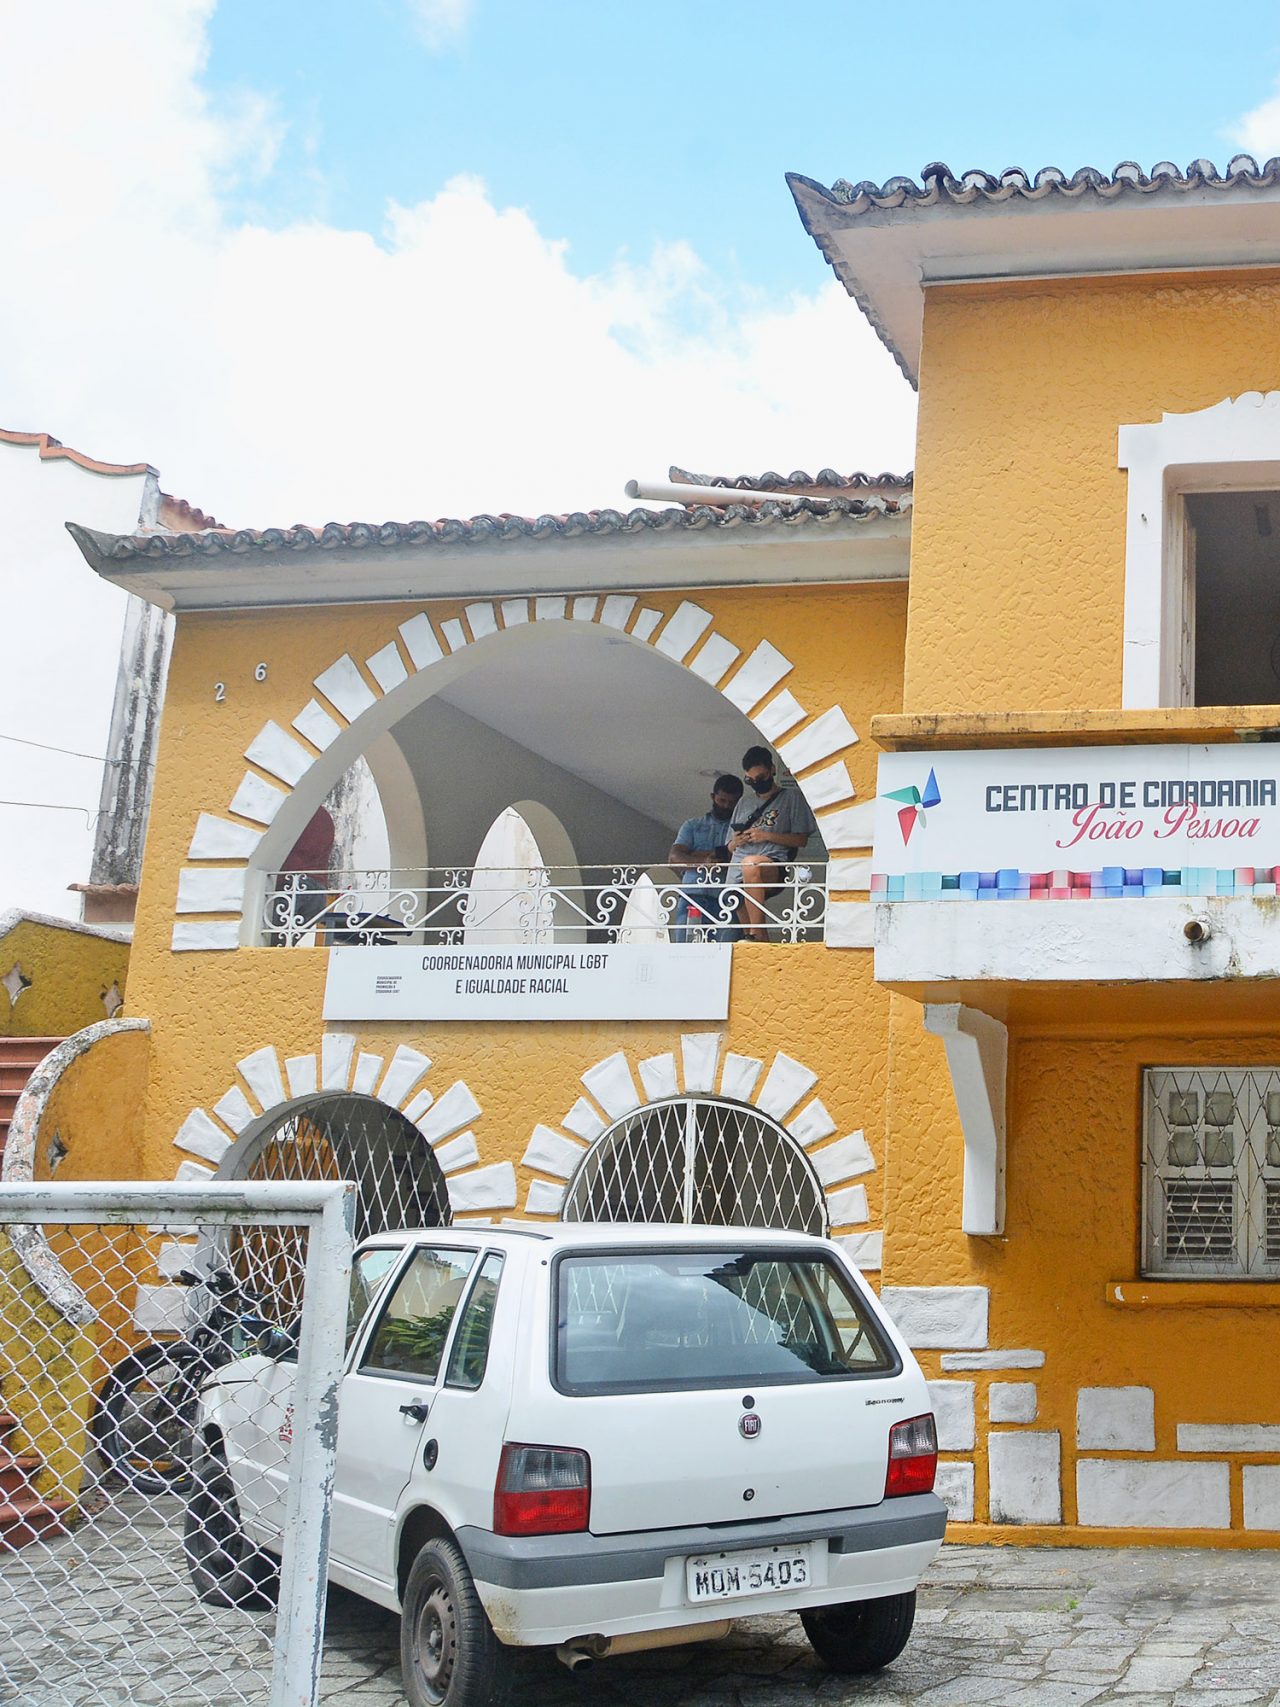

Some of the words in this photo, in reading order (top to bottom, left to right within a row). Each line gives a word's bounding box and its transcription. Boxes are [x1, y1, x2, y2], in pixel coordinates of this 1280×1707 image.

[985, 783, 1089, 813] CENTRO
[1099, 781, 1137, 810] DE
[1143, 779, 1277, 808] CIDADANIA
[1055, 801, 1144, 849] João
[1153, 800, 1262, 839] Pessoa
[422, 955, 514, 971] COORDENADORIA
[516, 954, 577, 971] MUNICIPAL
[579, 954, 609, 970] LGBT
[455, 979, 463, 994] E
[465, 978, 527, 994] IGUALDADE
[529, 978, 569, 994] RACIAL
[744, 1419, 759, 1432] FIAT
